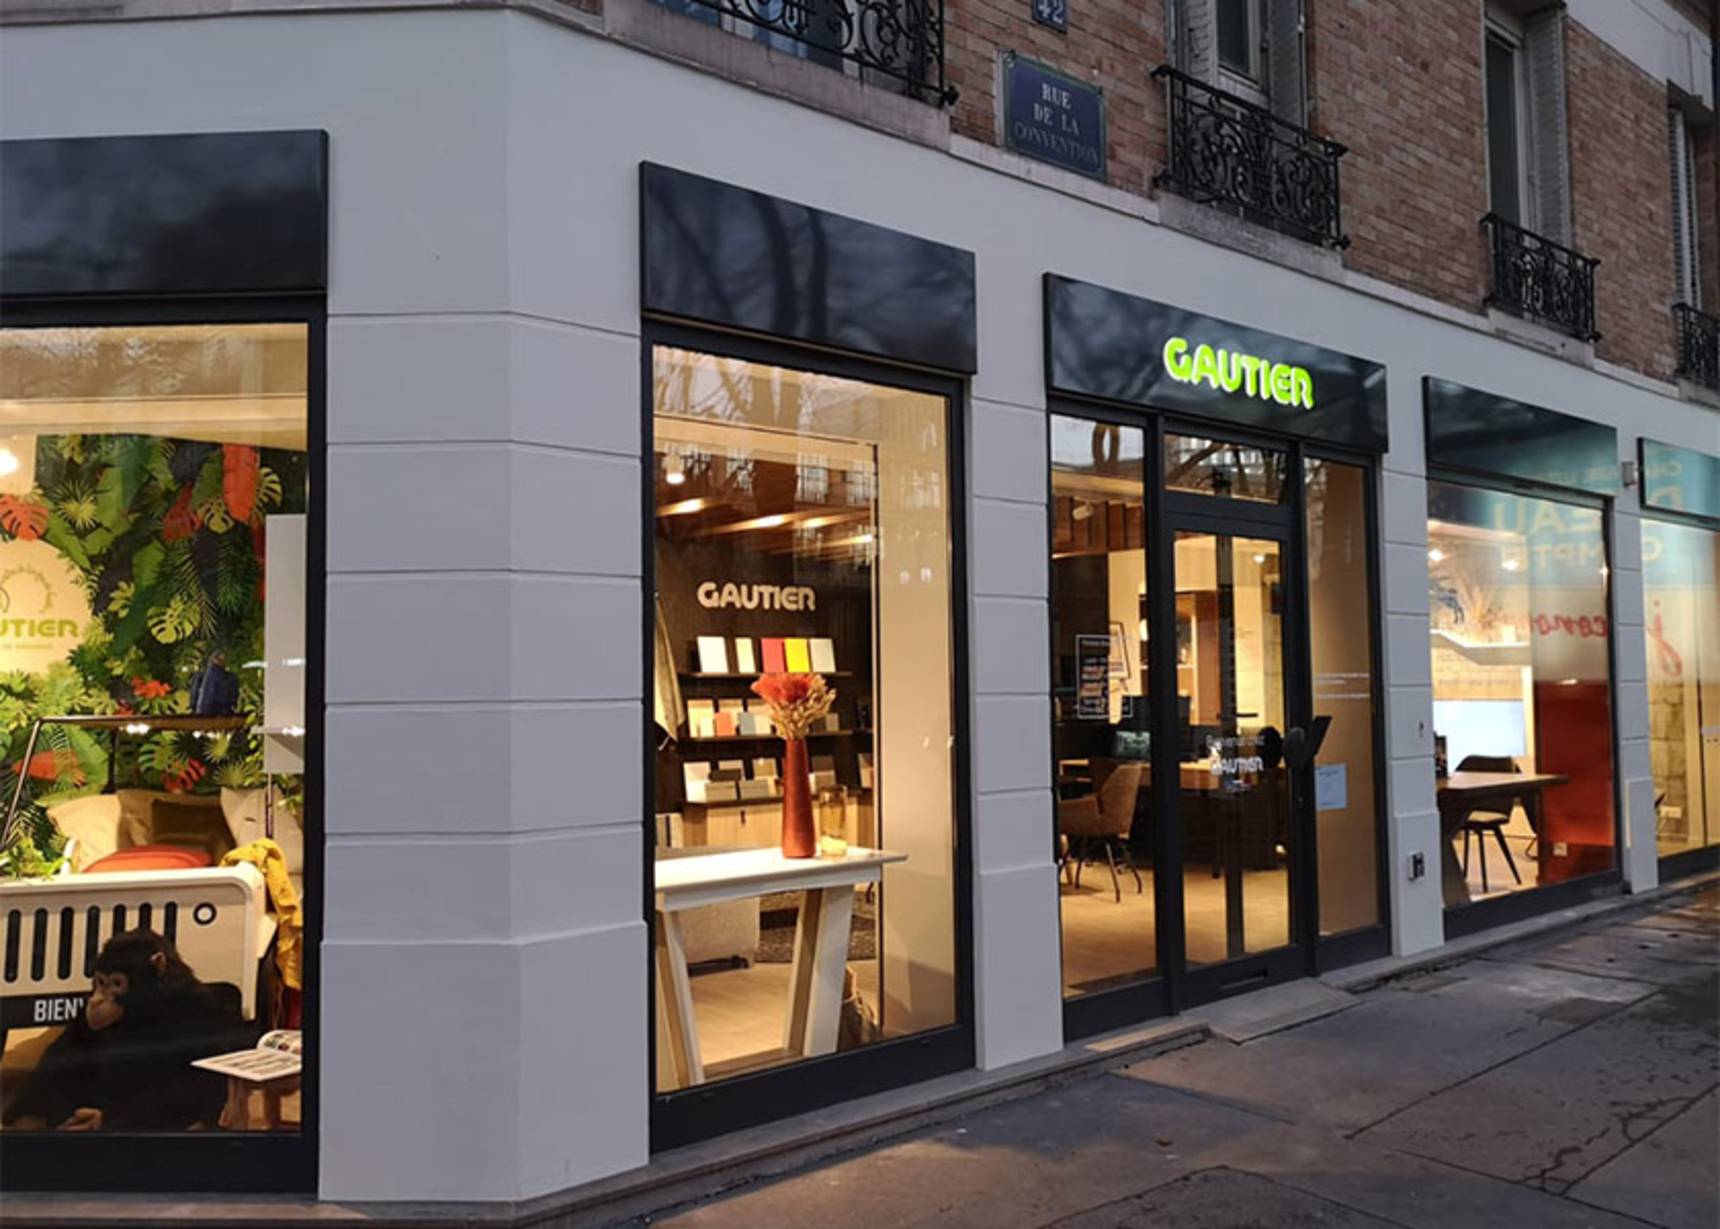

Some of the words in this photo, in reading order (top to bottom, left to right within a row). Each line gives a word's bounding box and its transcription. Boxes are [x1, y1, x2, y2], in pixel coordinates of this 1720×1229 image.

[1037, 0, 1064, 24] 42
[1041, 83, 1072, 110] RUE
[1033, 104, 1053, 127] DE
[1062, 114, 1080, 136] LA
[1014, 122, 1099, 165] CONVENTION
[1162, 336, 1315, 410] GAUTIER
[697, 581, 816, 611] GAUTIER
